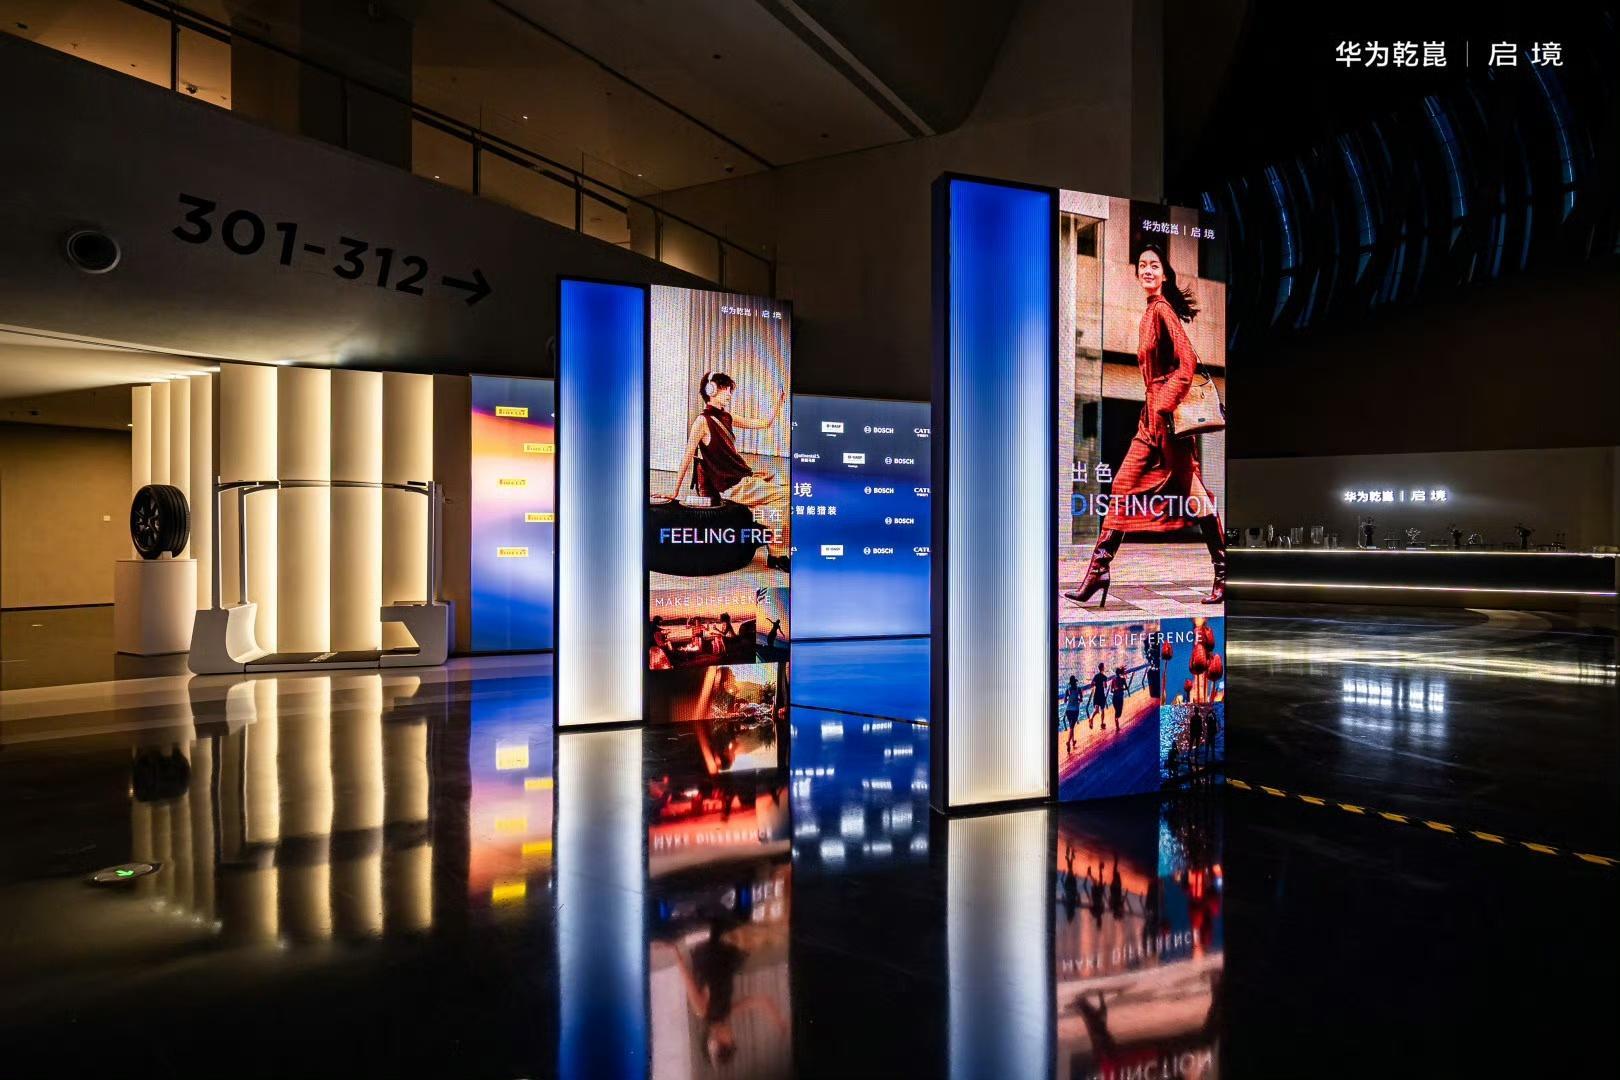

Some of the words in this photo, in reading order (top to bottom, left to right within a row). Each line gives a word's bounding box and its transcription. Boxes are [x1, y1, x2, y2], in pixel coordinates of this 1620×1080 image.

[171, 192, 429, 296] 301-312
[873, 426, 894, 434] BOSCH
[1072, 461, 1112, 484] 出色
[793, 482, 813, 498] 境
[873, 486, 895, 494] BOSCH
[1071, 494, 1218, 518] DISTINCTION
[894, 517, 915, 525] BOSCH
[660, 527, 736, 544] FEELING
[741, 528, 783, 544] FREE
[872, 547, 894, 555] BOSCH
[655, 597, 690, 606] MAKE
[696, 595, 771, 606] DIFFERENE
[1064, 635, 1106, 648] MAKE
[1114, 630, 1203, 646] DIFFERENCE
